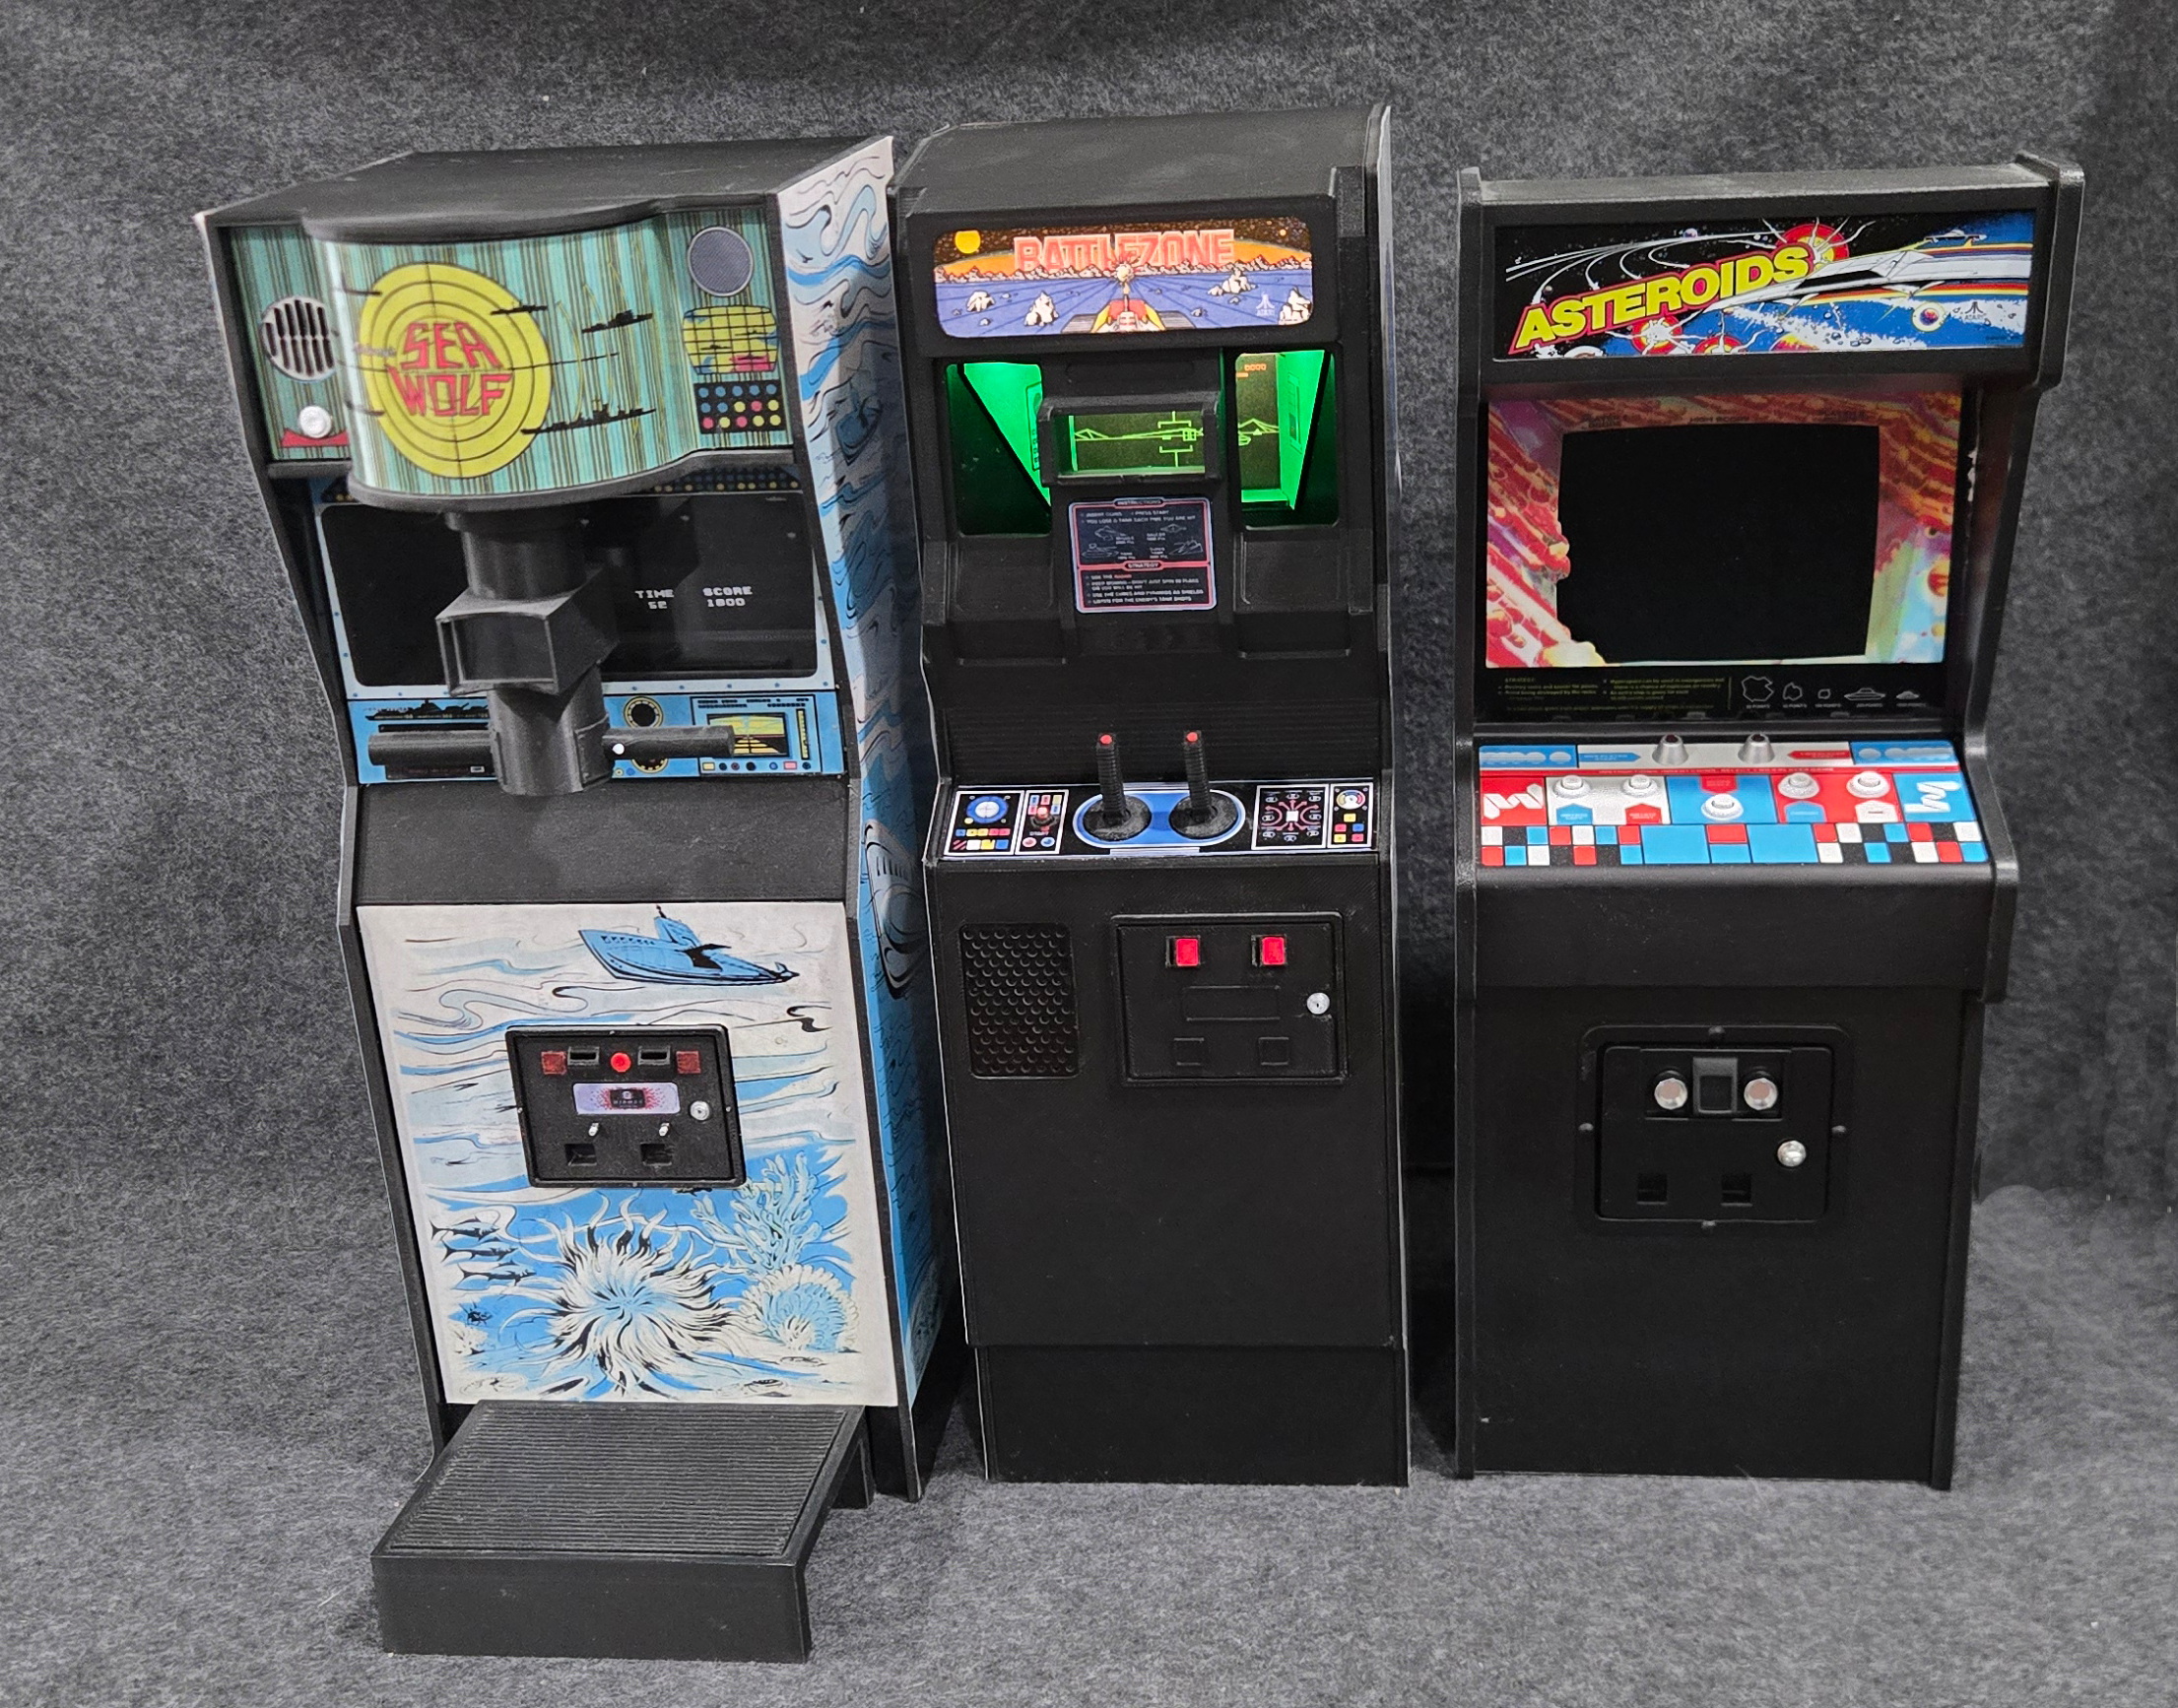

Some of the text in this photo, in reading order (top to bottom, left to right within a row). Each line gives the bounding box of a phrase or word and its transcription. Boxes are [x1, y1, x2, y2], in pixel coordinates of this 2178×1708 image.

[1014, 230, 1234, 273] BATTLEZONE
[1511, 244, 1814, 351] ASTEROIDS
[400, 322, 504, 369] SEA
[384, 363, 513, 417] WOLF
[634, 589, 674, 599] TIME
[702, 586, 753, 597] SCORE
